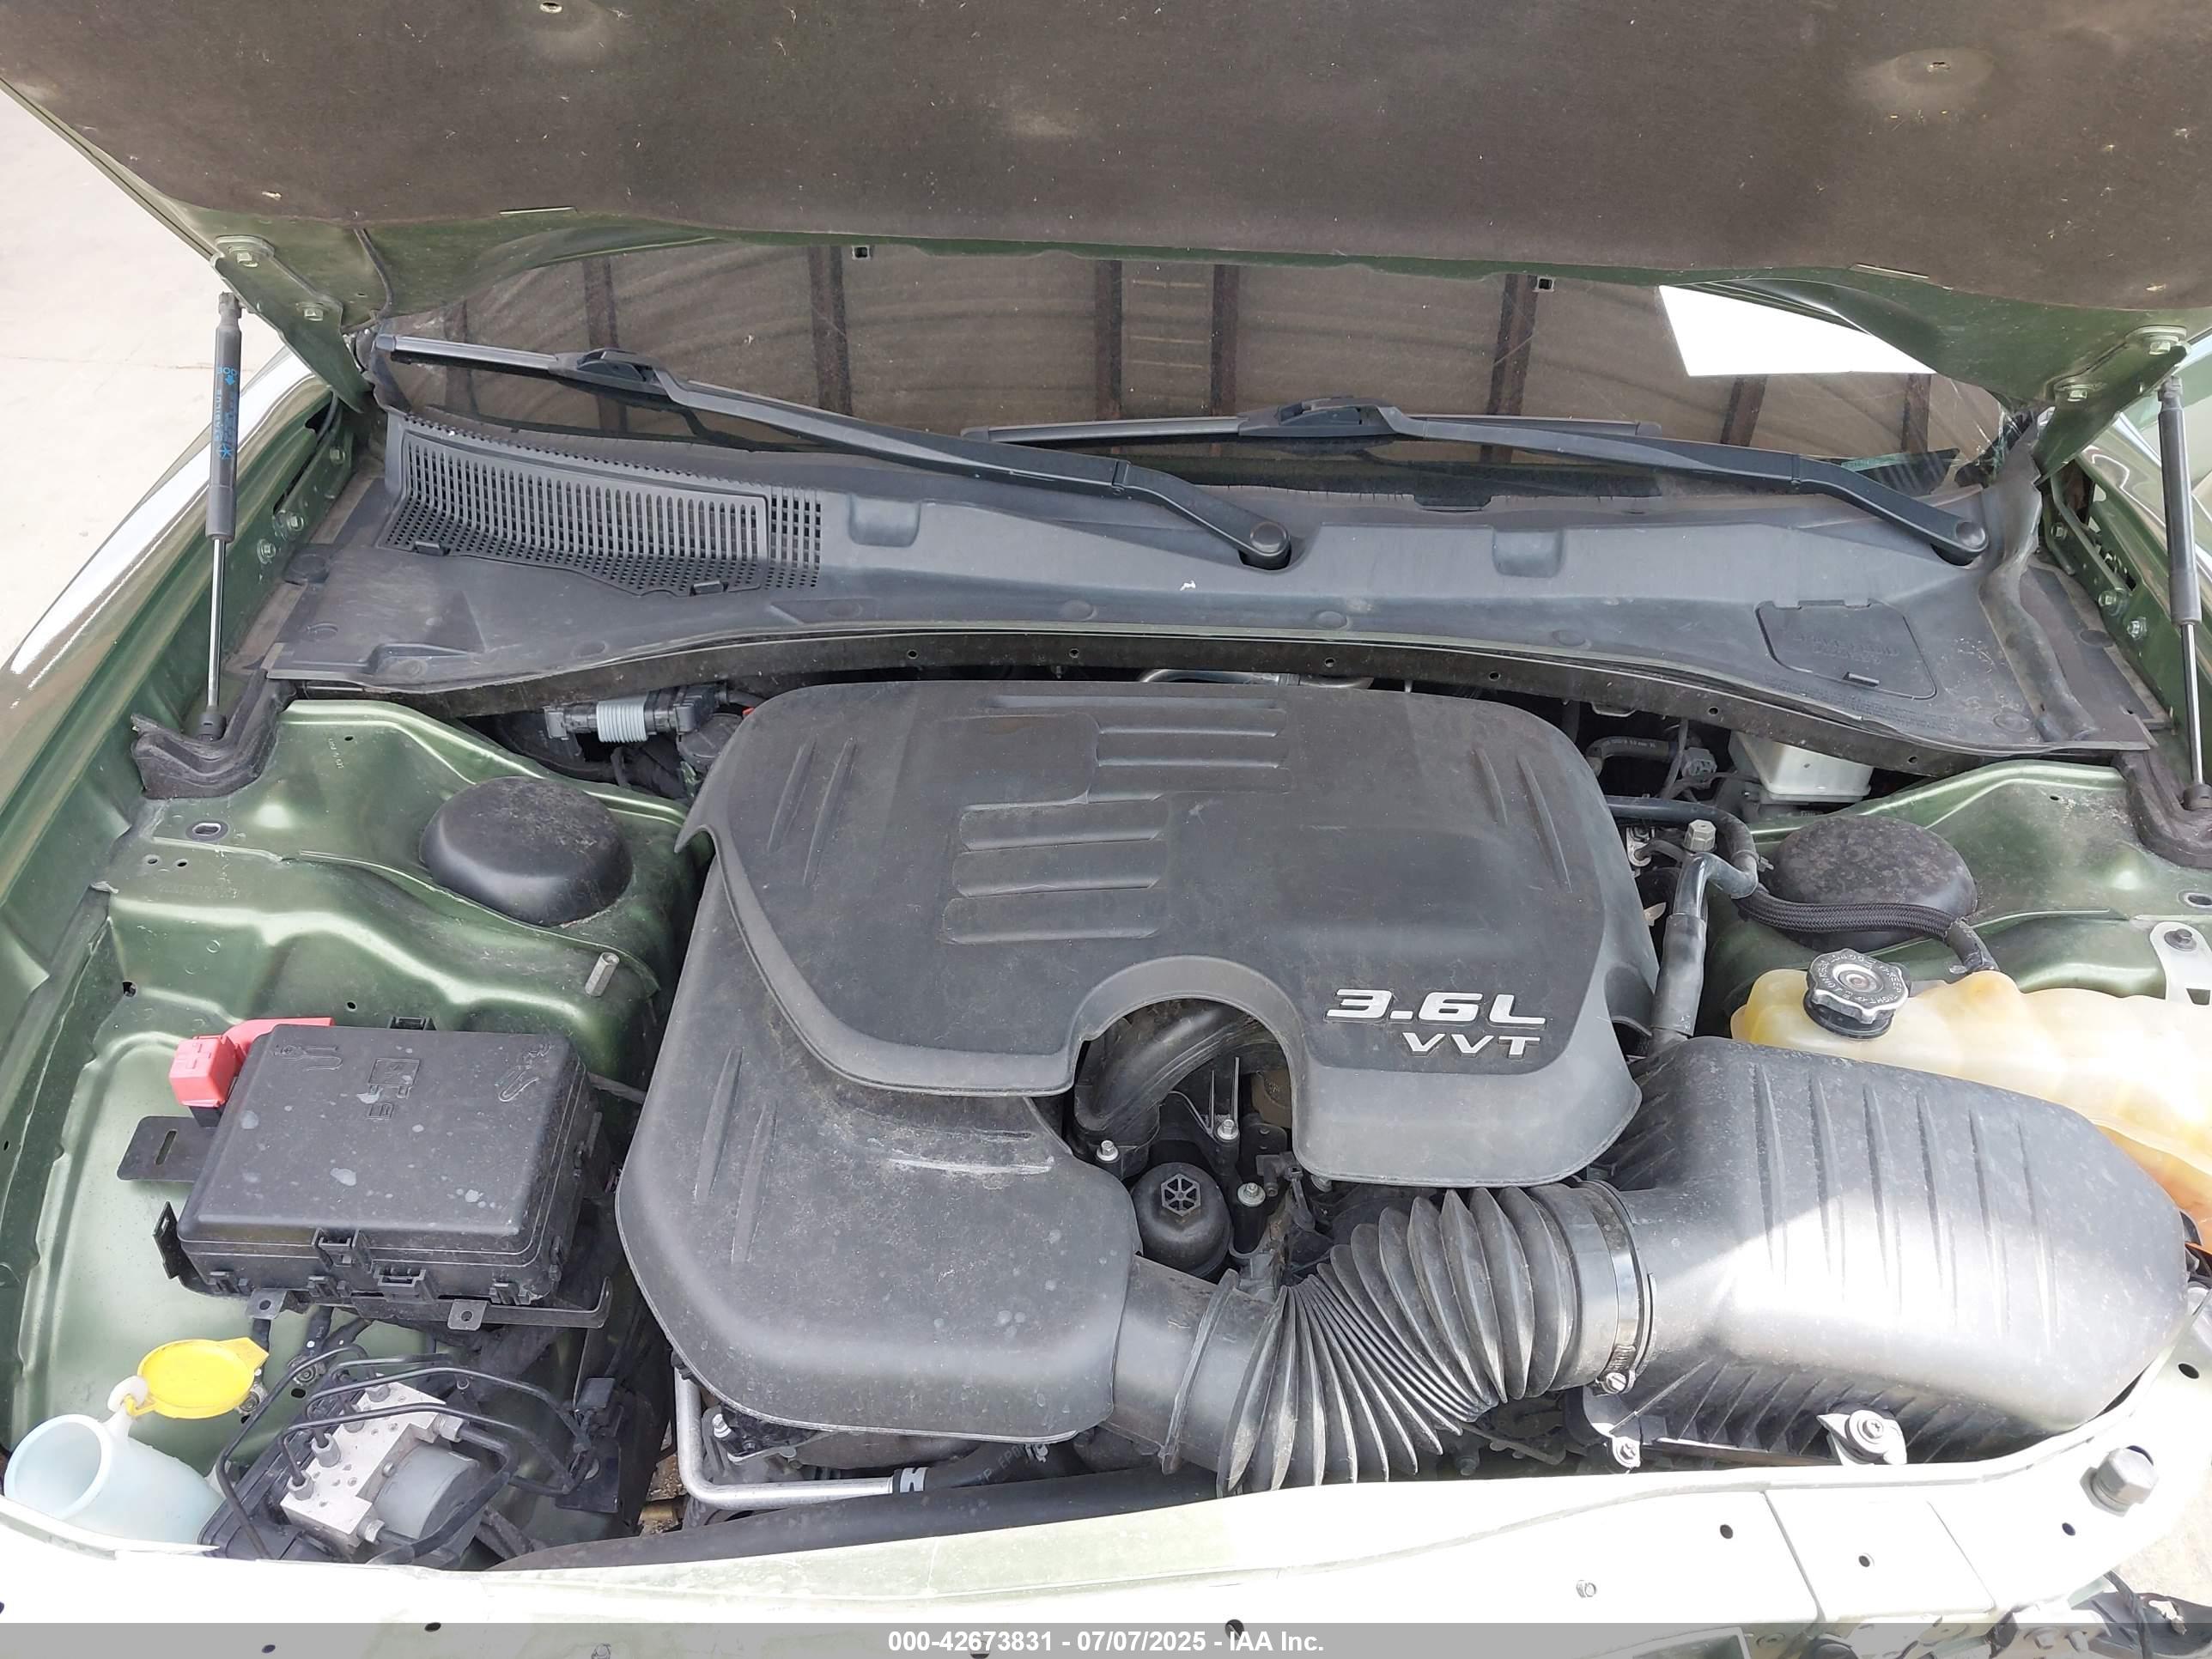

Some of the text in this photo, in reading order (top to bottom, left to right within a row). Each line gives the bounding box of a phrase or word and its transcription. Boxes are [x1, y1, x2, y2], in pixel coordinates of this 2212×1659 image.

[217, 367, 240, 376] BOD
[1326, 988, 1547, 1025] 3.6L
[1402, 1032, 1540, 1057] VVT
